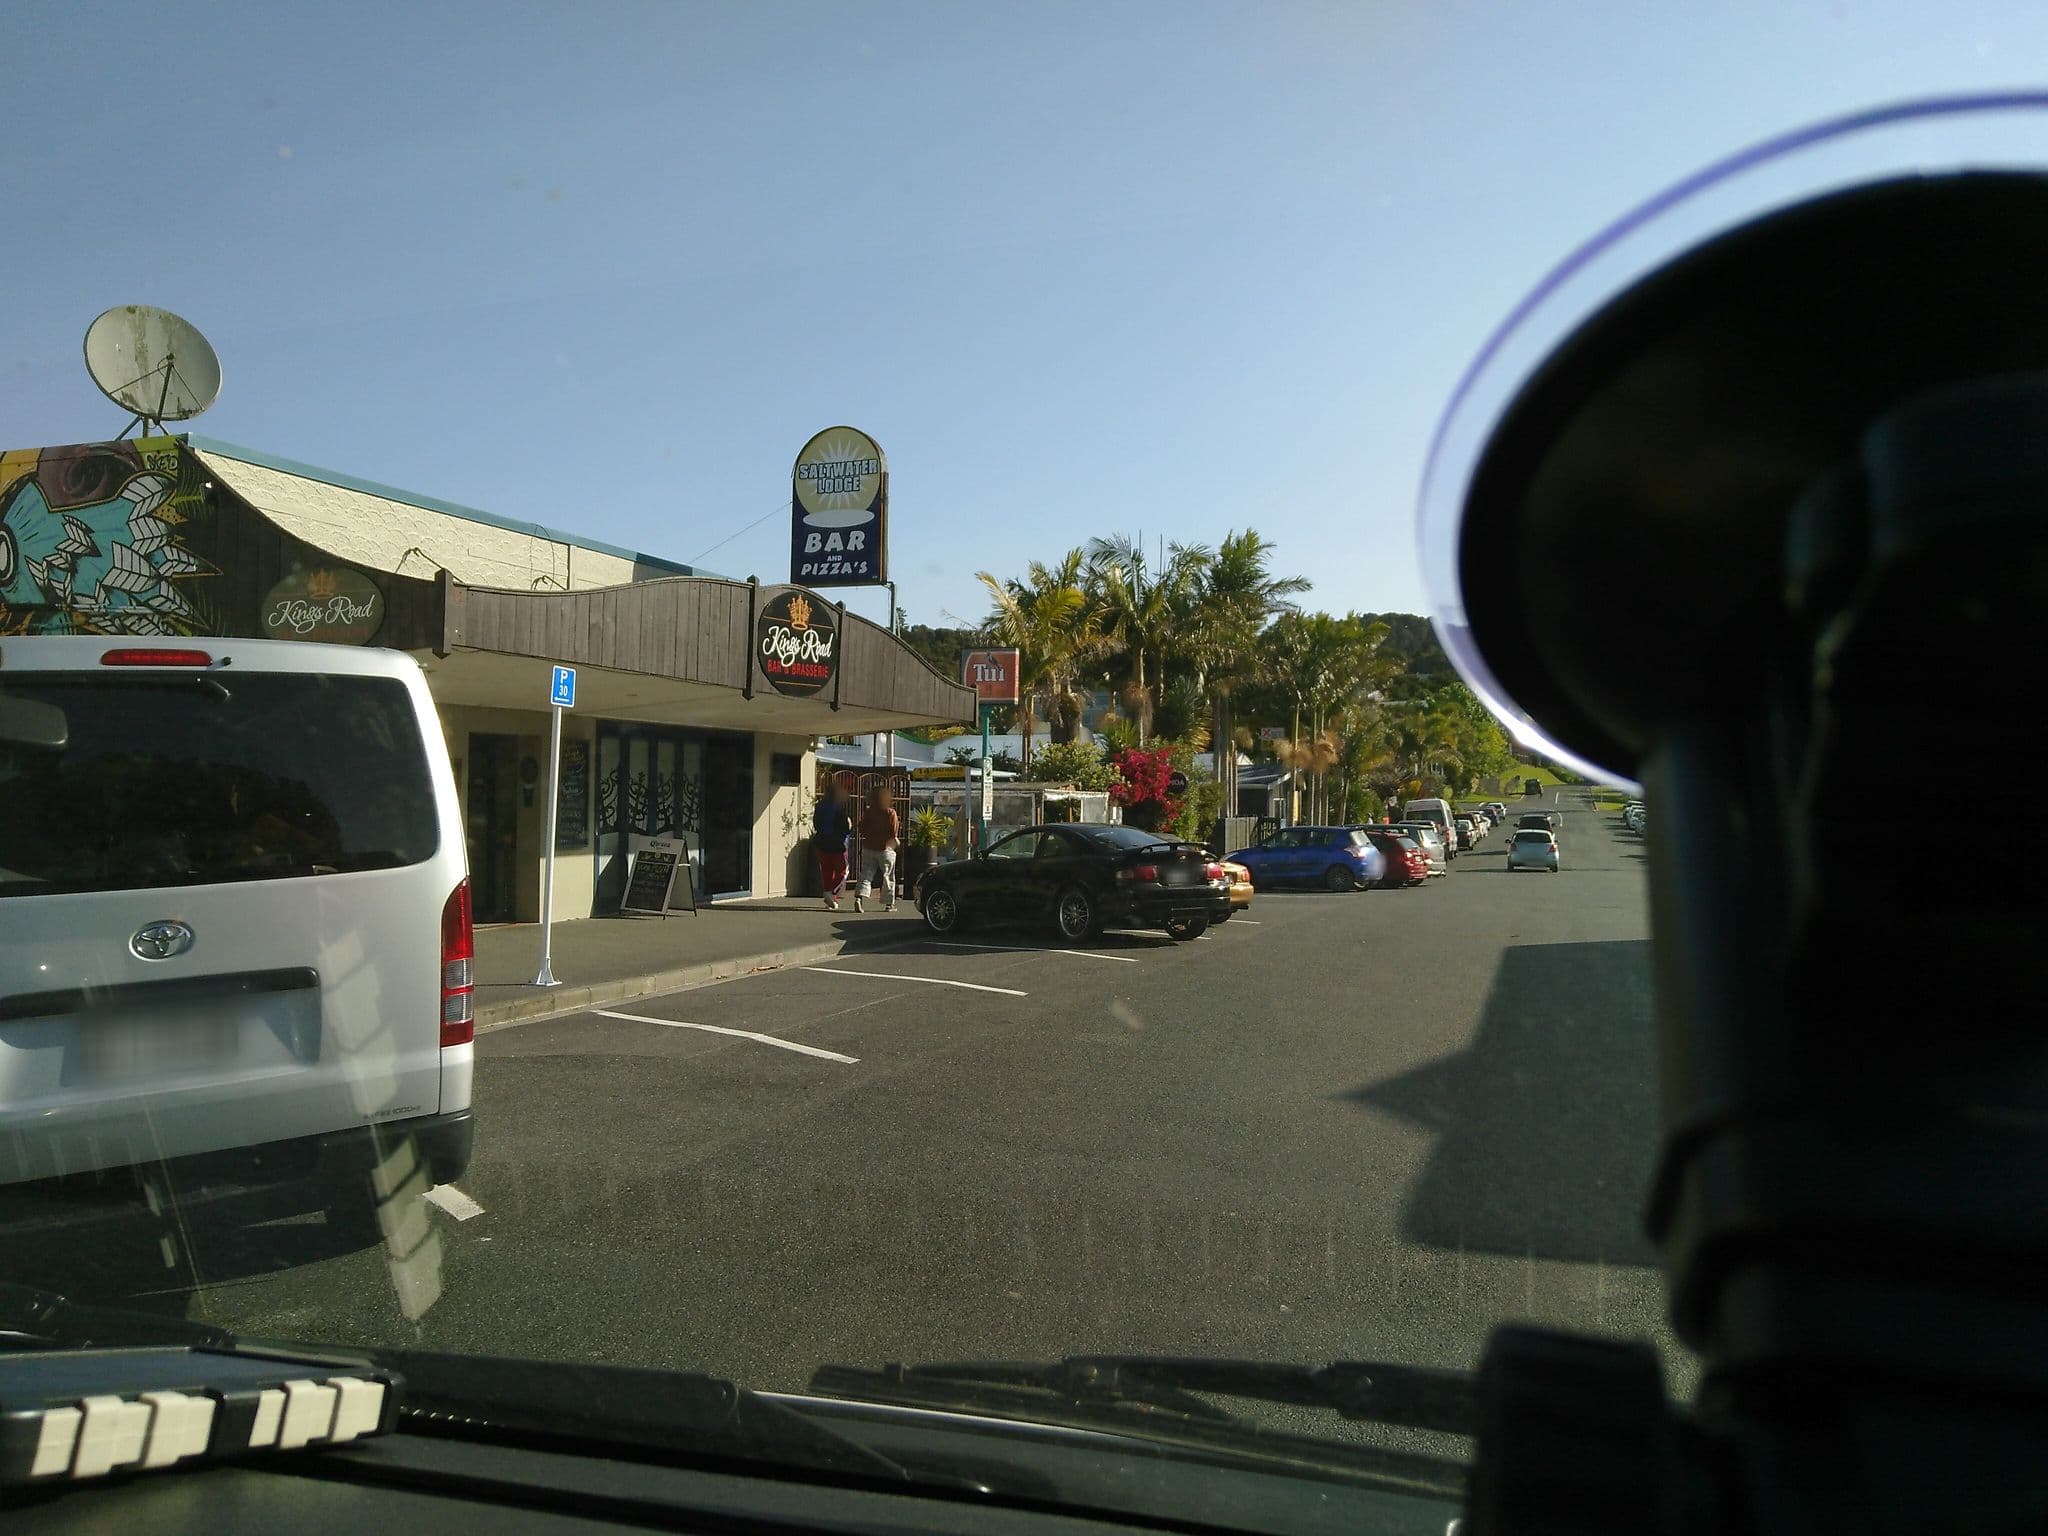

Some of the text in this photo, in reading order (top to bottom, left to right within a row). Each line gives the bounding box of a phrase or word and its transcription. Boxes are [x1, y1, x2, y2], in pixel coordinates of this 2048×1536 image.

[799, 459, 878, 480] SALTWATER
[816, 476, 861, 494] LODGE
[804, 530, 866, 553] BAR
[800, 561, 868, 575] PIZZA'S
[268, 594, 376, 633] Kings Road
[762, 626, 834, 667] Kings Road
[560, 670, 568, 684] P
[767, 660, 781, 673] BAR
[791, 663, 829, 678] BRASSERIE
[973, 664, 1005, 682] Tui
[559, 684, 569, 697] 30
